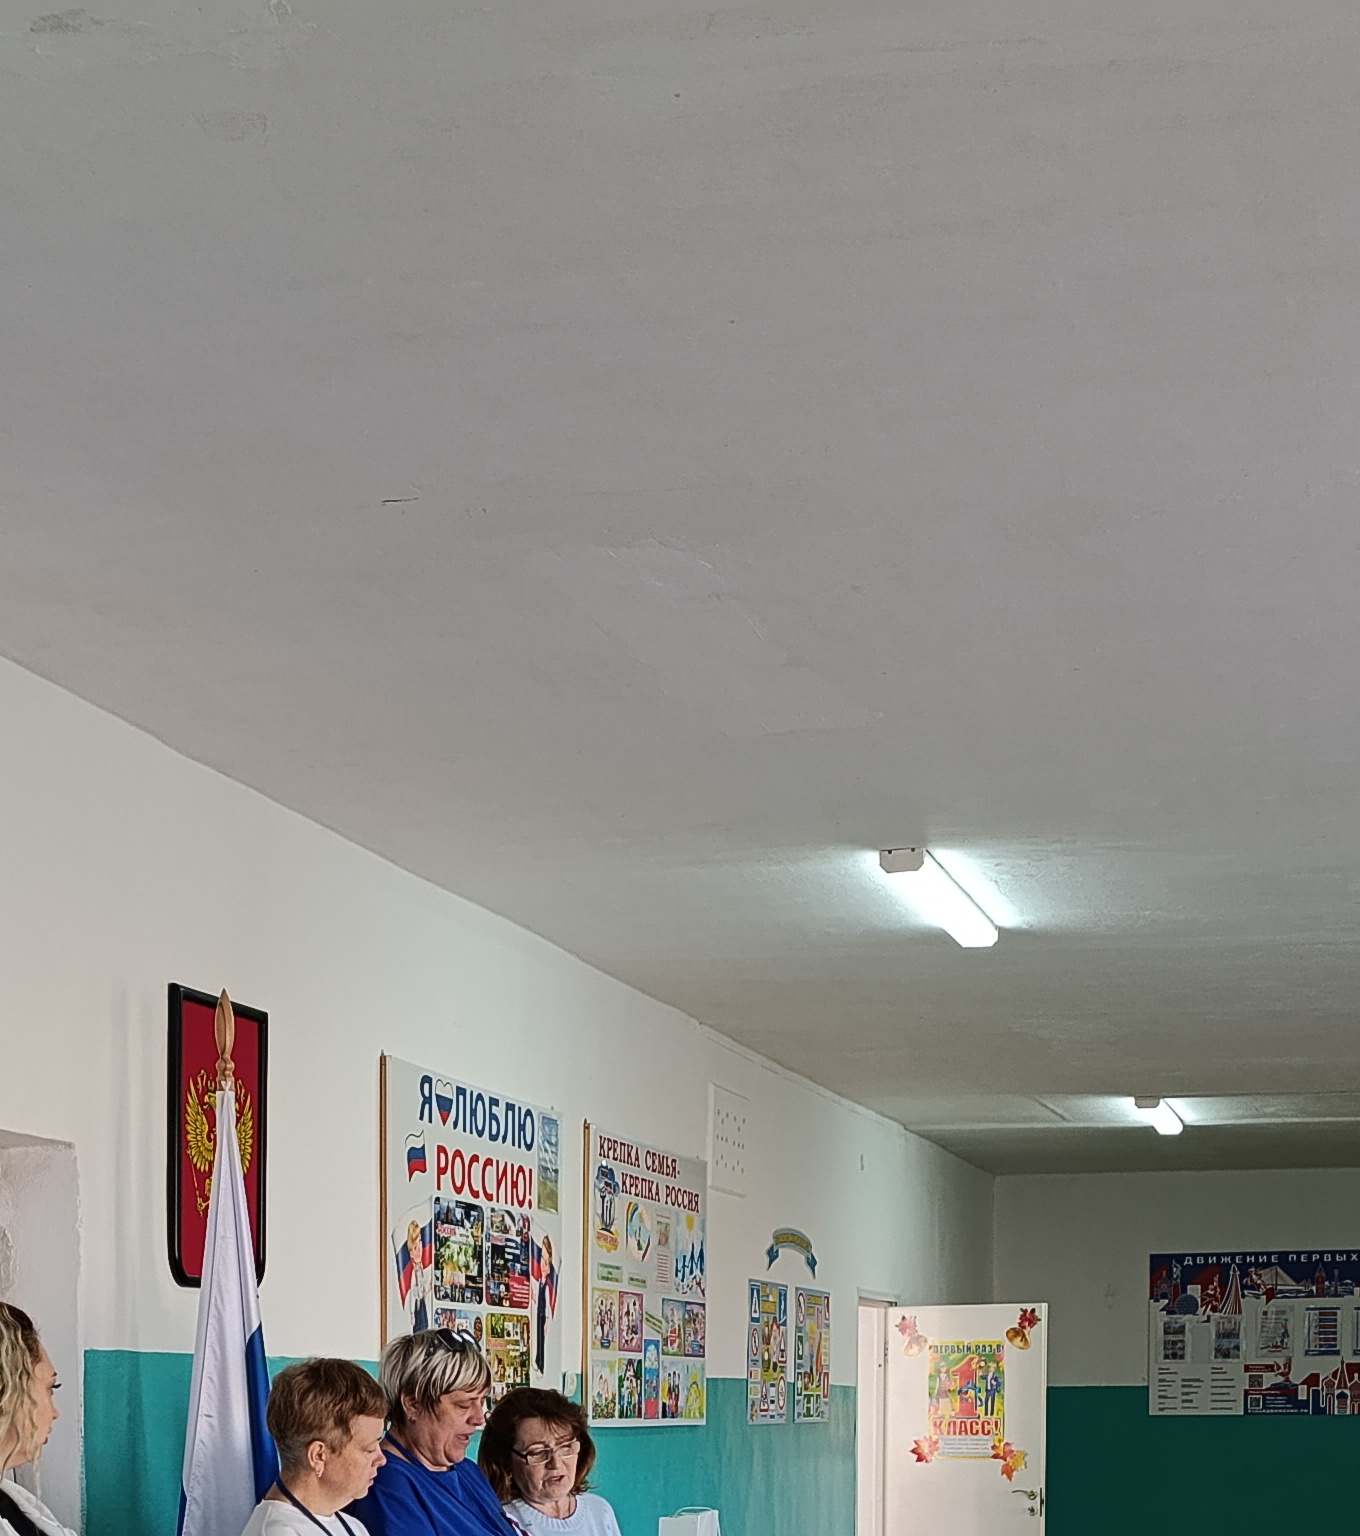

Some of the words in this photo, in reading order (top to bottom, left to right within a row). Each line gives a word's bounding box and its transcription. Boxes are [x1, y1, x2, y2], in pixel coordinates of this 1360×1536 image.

[419, 1074, 433, 1125] Я
[452, 1085, 535, 1152] ЛЮБЛЮ
[598, 1135, 641, 1169] КРЕПКА
[436, 1144, 533, 1210] РОССИЮ!
[620, 1171, 661, 1203] КРЕПКА
[664, 1184, 700, 1214] РОССИЯ
[1183, 1254, 1279, 1266] ДВИЖЕНИЕ
[1288, 1253, 1359, 1262] ПЕРВЫХ
[933, 1341, 972, 1354] ПЕРВЫЙ
[975, 1344, 993, 1354] РАЗ
[933, 1419, 1001, 1437] КЛАСС!
